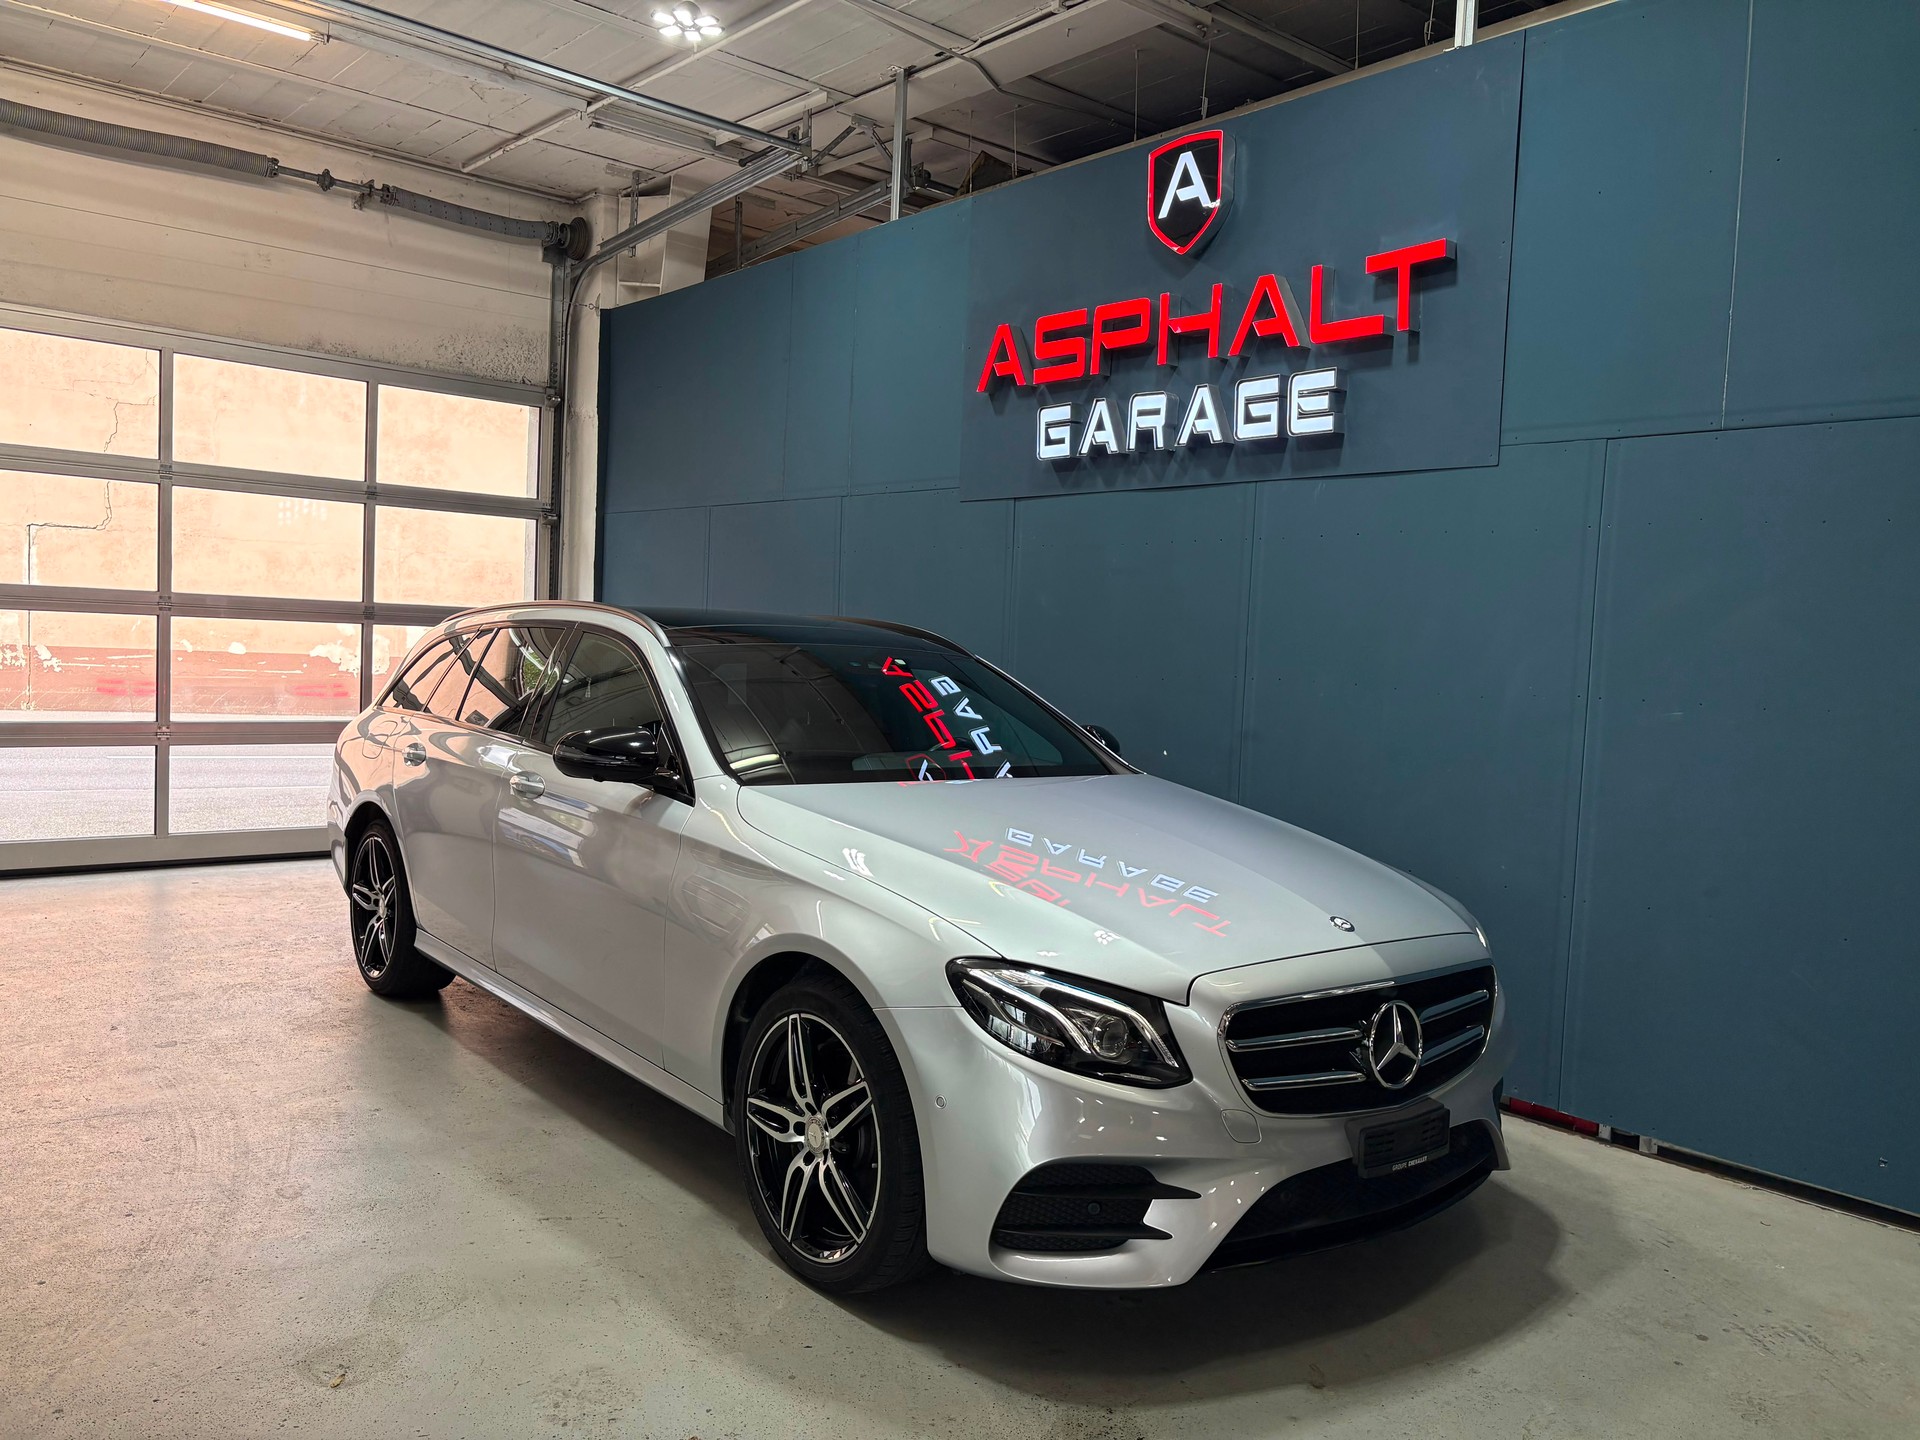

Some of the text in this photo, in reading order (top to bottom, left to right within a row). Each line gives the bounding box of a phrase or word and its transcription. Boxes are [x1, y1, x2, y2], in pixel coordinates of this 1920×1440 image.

[1158, 150, 1213, 219] A
[976, 237, 1448, 393] ASPHALT
[1036, 366, 1338, 461] GARAGE
